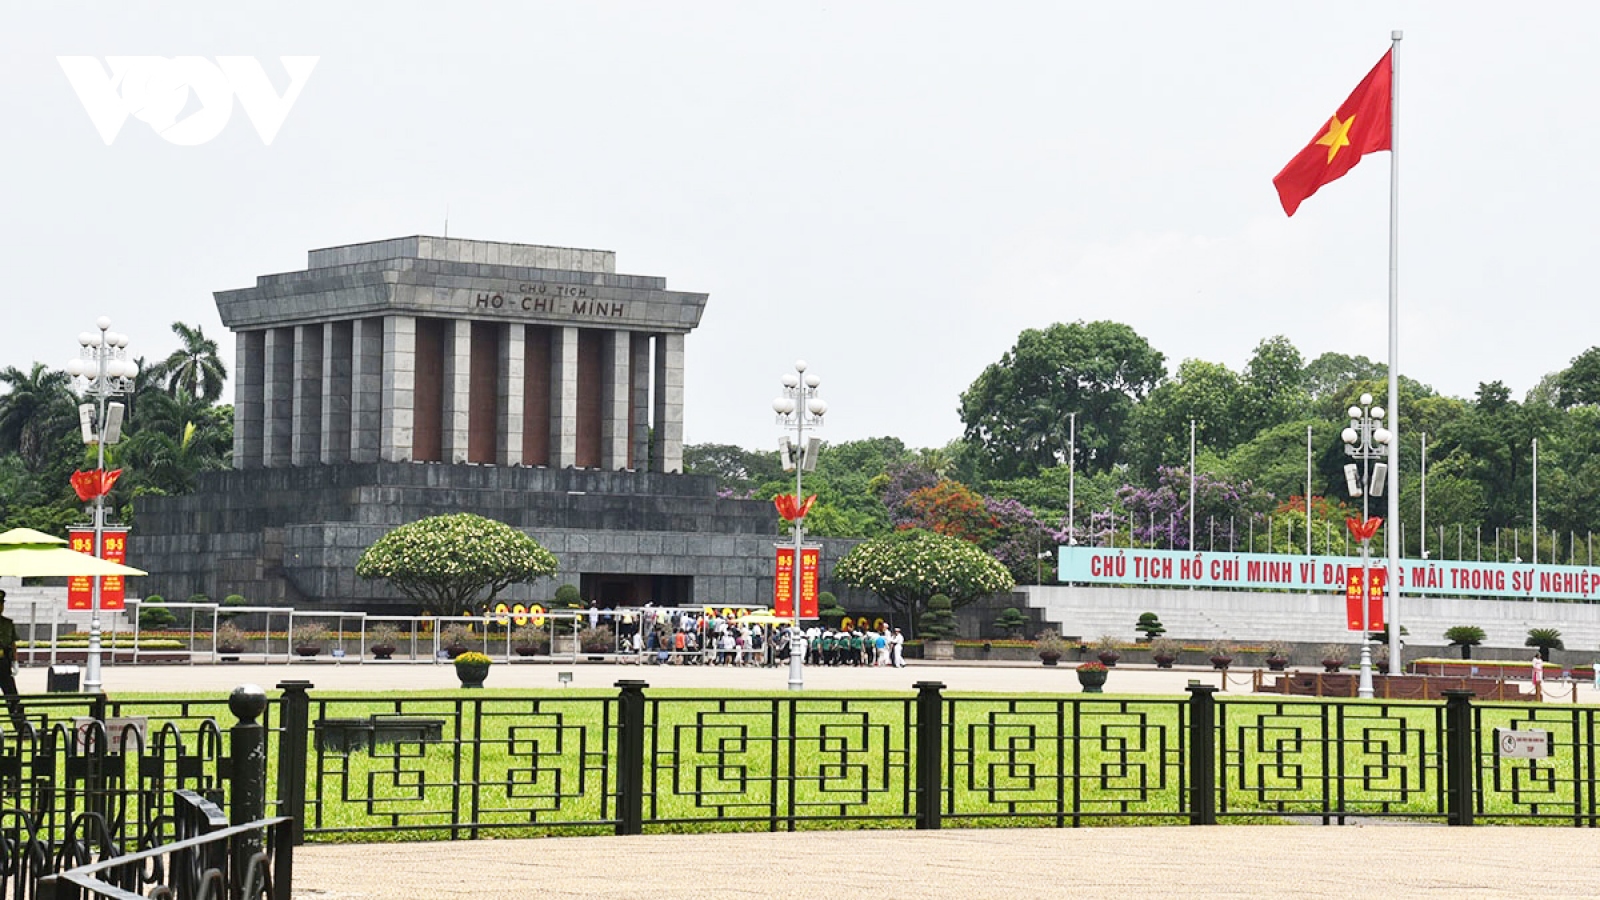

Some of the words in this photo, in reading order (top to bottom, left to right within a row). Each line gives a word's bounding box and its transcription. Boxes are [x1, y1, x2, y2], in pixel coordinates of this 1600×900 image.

[73, 538, 92, 551] 19-5
[105, 538, 124, 551] 19-5
[1091, 549, 1126, 577] CHỦ
[1133, 556, 1172, 582] TỊCH
[1180, 552, 1203, 580] HỒ
[1210, 555, 1240, 581] CHÍ
[1247, 560, 1292, 583] MINH
[1300, 559, 1317, 584] VĨ
[1323, 563, 1345, 588] ĐẠ
[1412, 563, 1443, 588] MÃI
[1450, 568, 1505, 591] TRONG
[1512, 568, 1535, 595] SỰ
[1540, 568, 1600, 598] NGHIỆP
